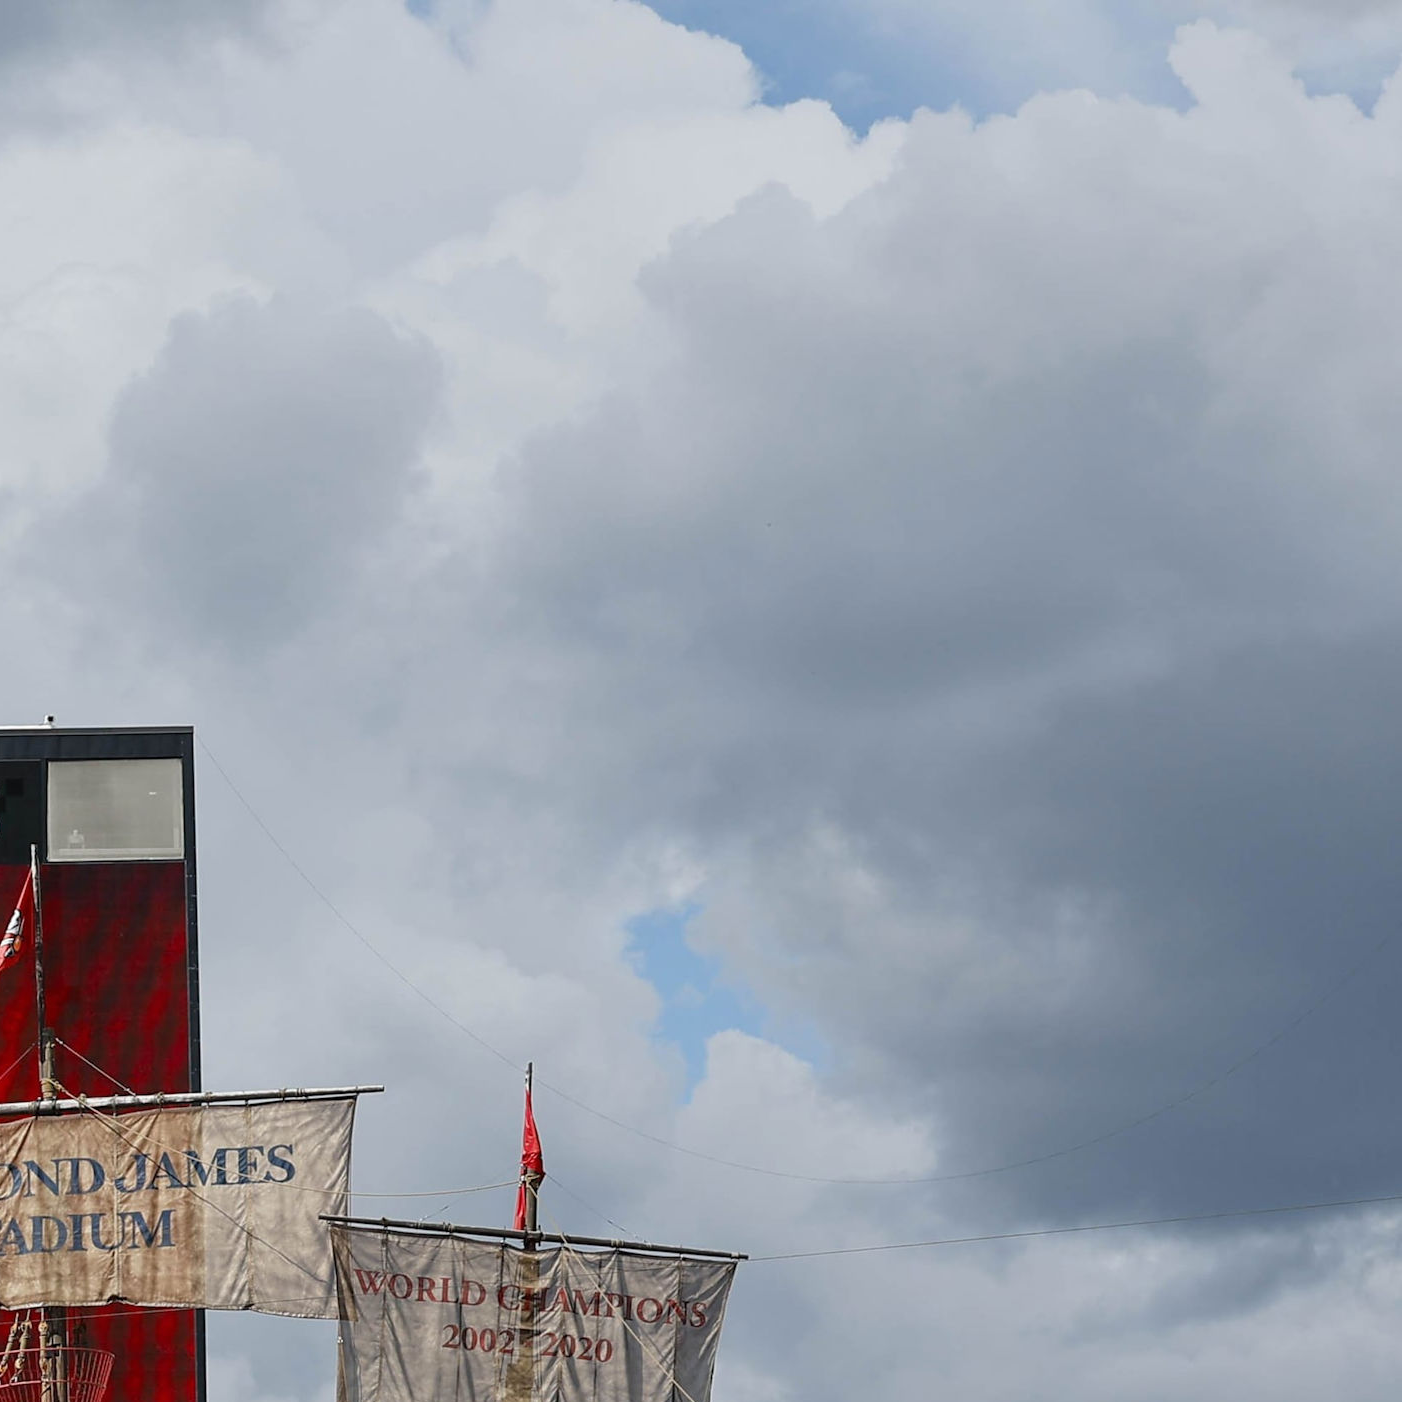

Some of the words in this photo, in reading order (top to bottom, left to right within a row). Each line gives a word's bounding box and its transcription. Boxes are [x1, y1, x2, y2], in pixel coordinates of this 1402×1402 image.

[114, 1142, 296, 1194] JAMES
[353, 1268, 487, 1308] WORLD
[497, 1283, 708, 1329] CHAMPIONS
[442, 1323, 514, 1356] 2002
[541, 1331, 613, 1364] 2020
